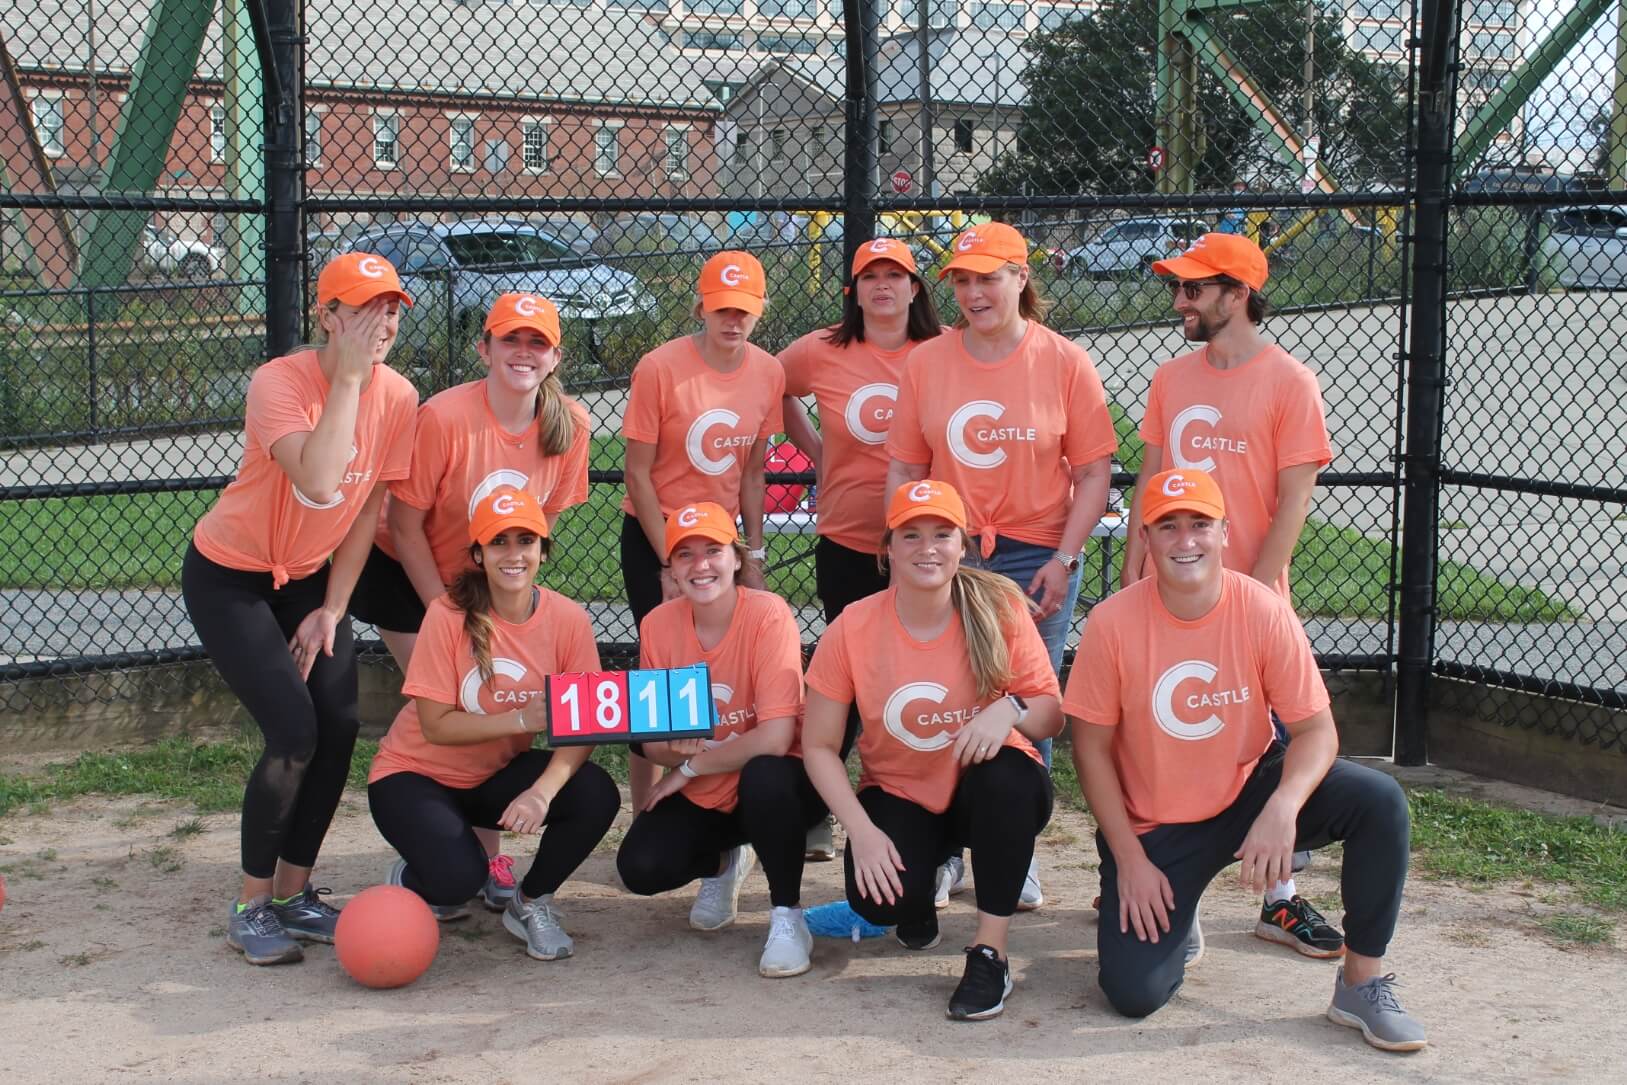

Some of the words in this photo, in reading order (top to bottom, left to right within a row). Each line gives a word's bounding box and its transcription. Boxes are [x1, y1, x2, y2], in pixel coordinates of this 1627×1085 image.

[686, 408, 740, 476] C
[947, 400, 1007, 469] C
[977, 428, 1037, 441] CASTLE
[1170, 404, 1222, 473] C
[1191, 435, 1248, 453] CASTLE
[494, 690, 543, 703] CAST
[718, 704, 758, 726] ASTL
[1152, 660, 1224, 740] C
[1187, 687, 1250, 709] CASTLE
